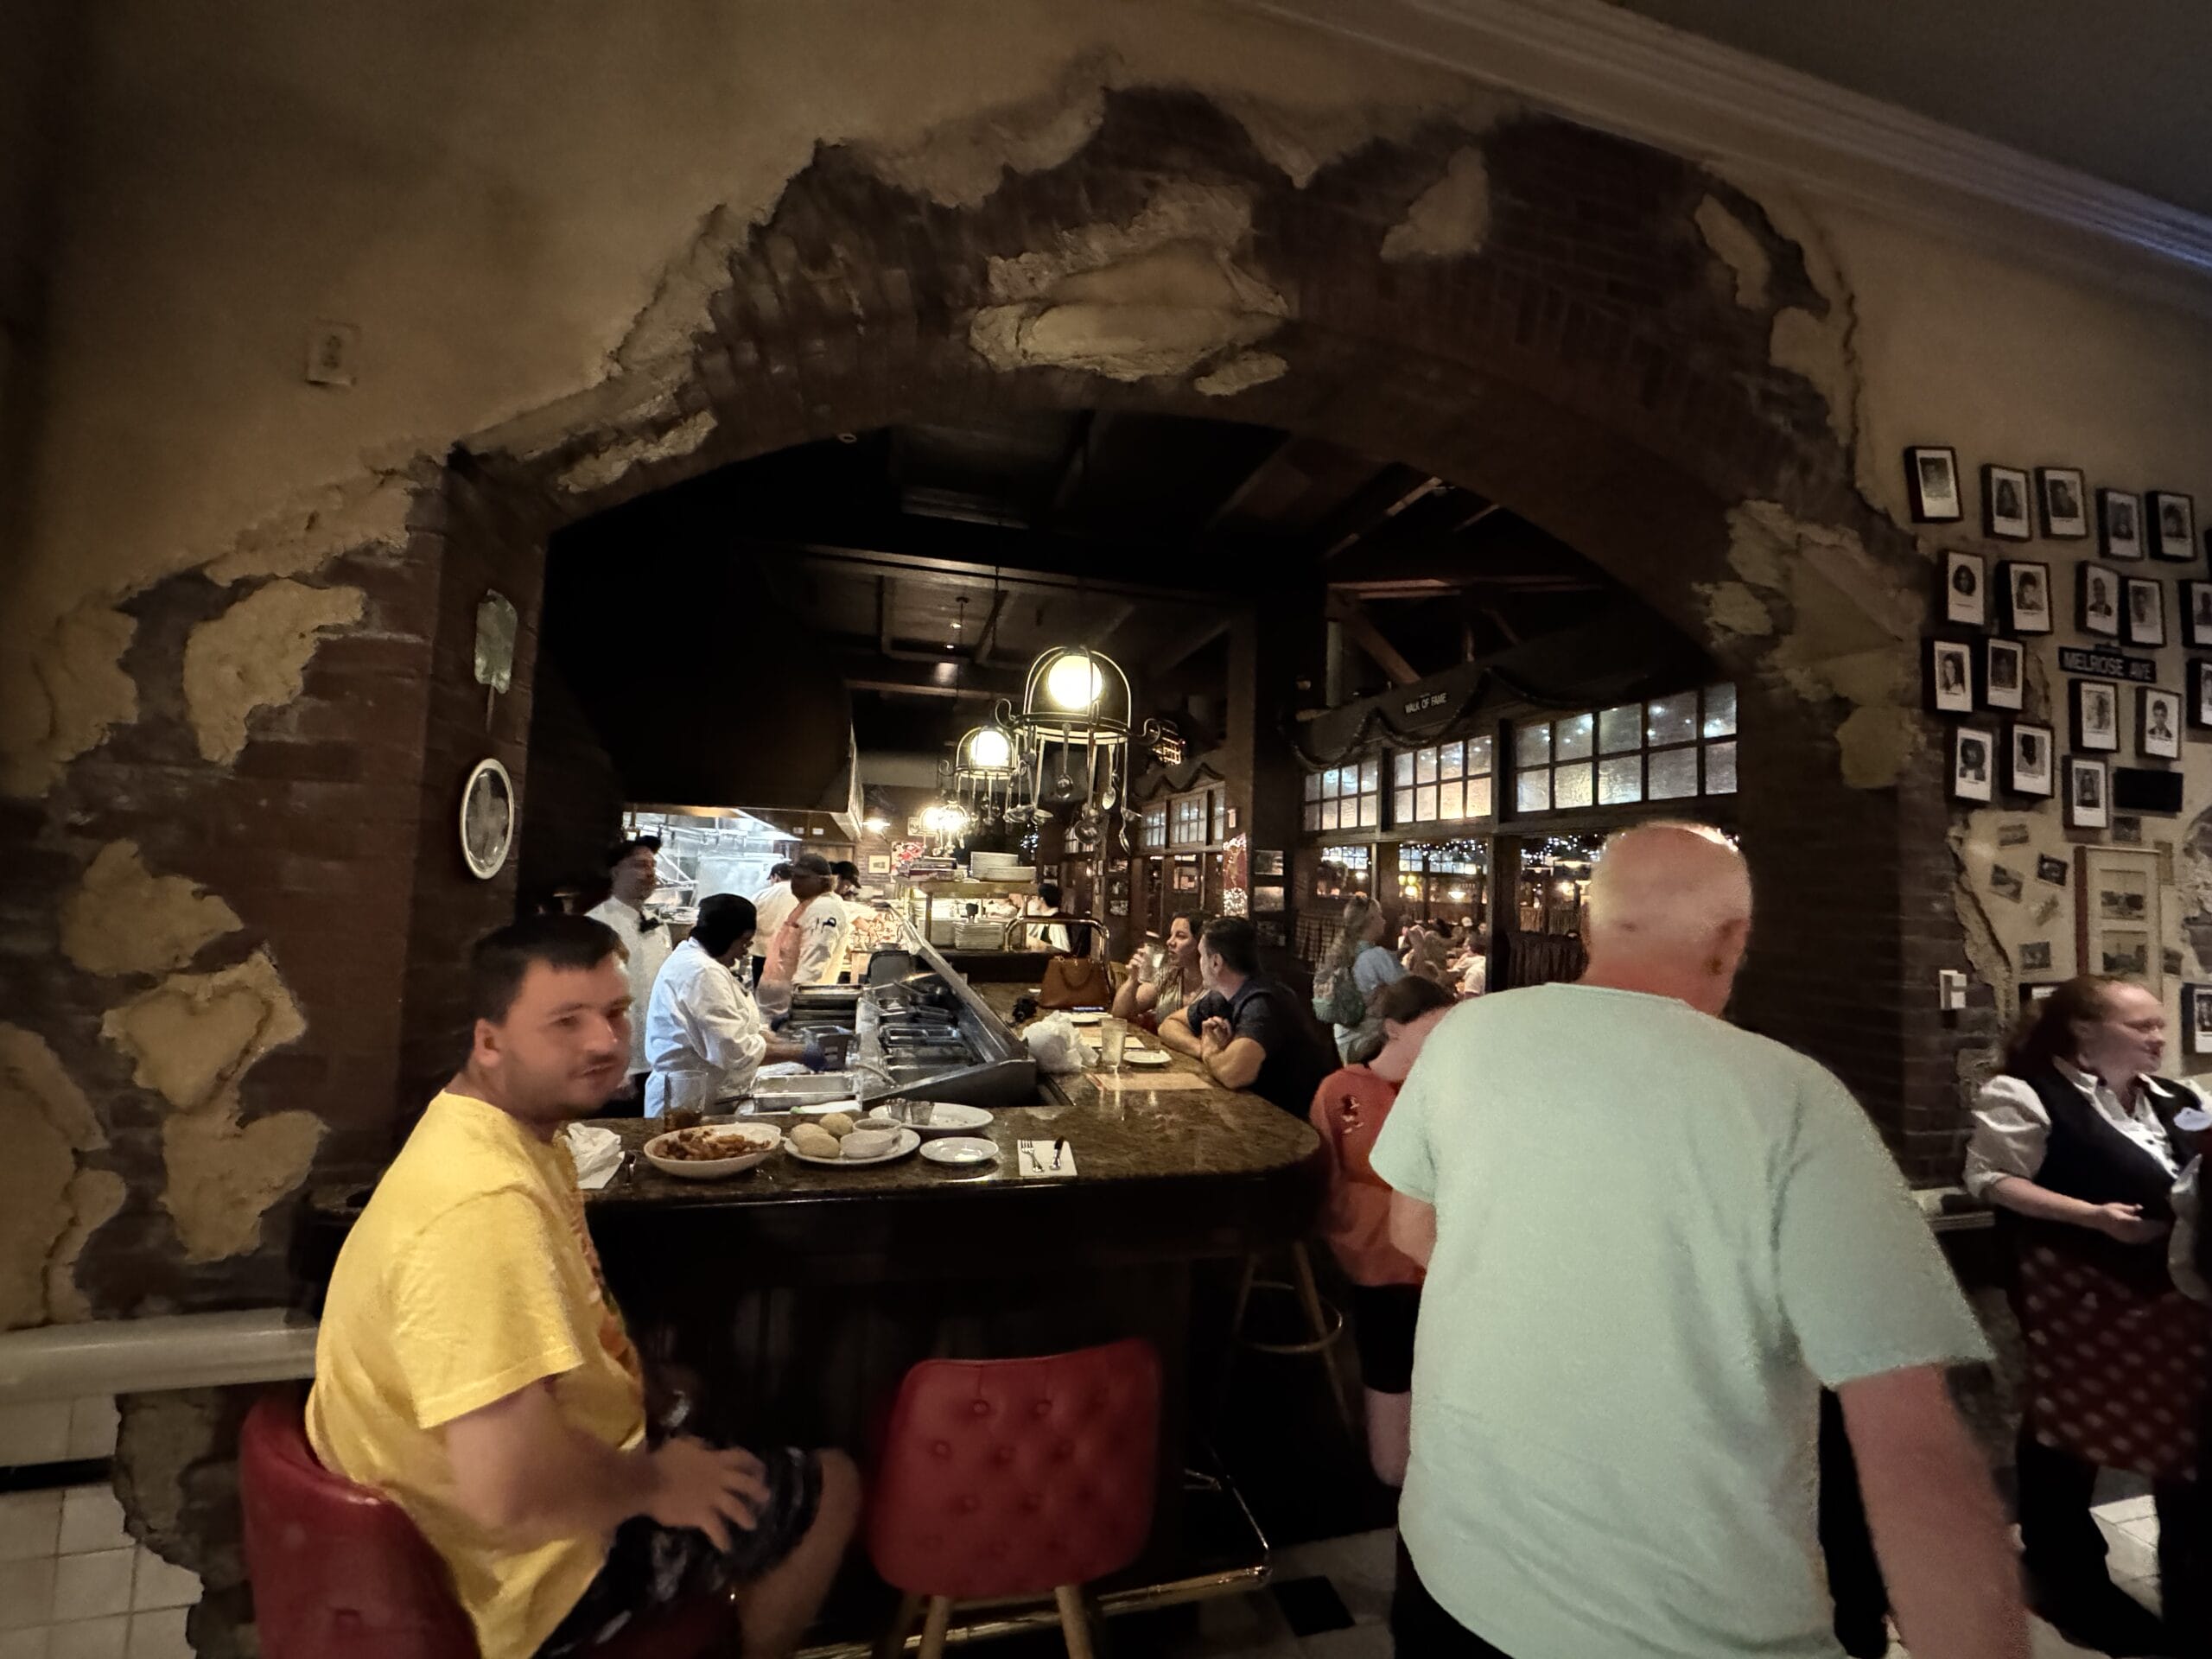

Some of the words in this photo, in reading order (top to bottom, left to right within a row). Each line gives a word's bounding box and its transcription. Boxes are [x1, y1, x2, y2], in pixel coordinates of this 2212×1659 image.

[2063, 651, 2124, 677] MELROSE
[1405, 700, 1421, 714] WALK
[1421, 697, 1430, 709] OF
[1431, 692, 1447, 707] FAME
